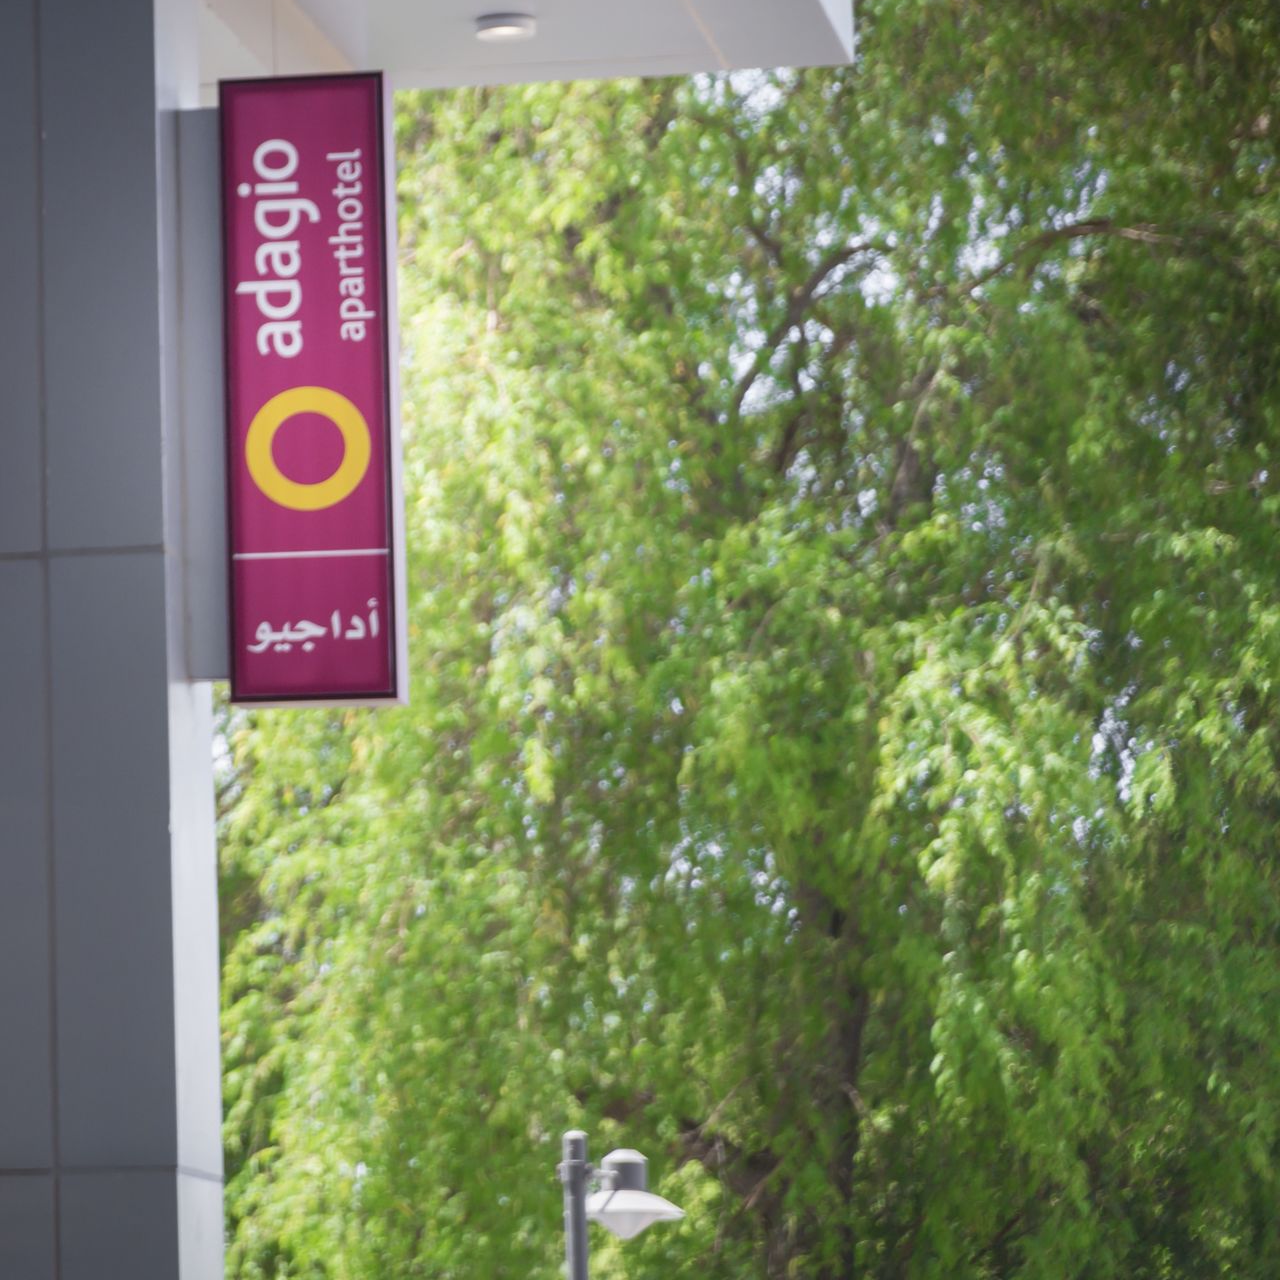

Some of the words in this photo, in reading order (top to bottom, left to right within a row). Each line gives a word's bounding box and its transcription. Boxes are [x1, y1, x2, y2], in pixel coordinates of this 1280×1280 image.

[236, 139, 321, 358] adagio
[326, 148, 376, 342] aparthotel
[246, 597, 380, 654] أداجيو
